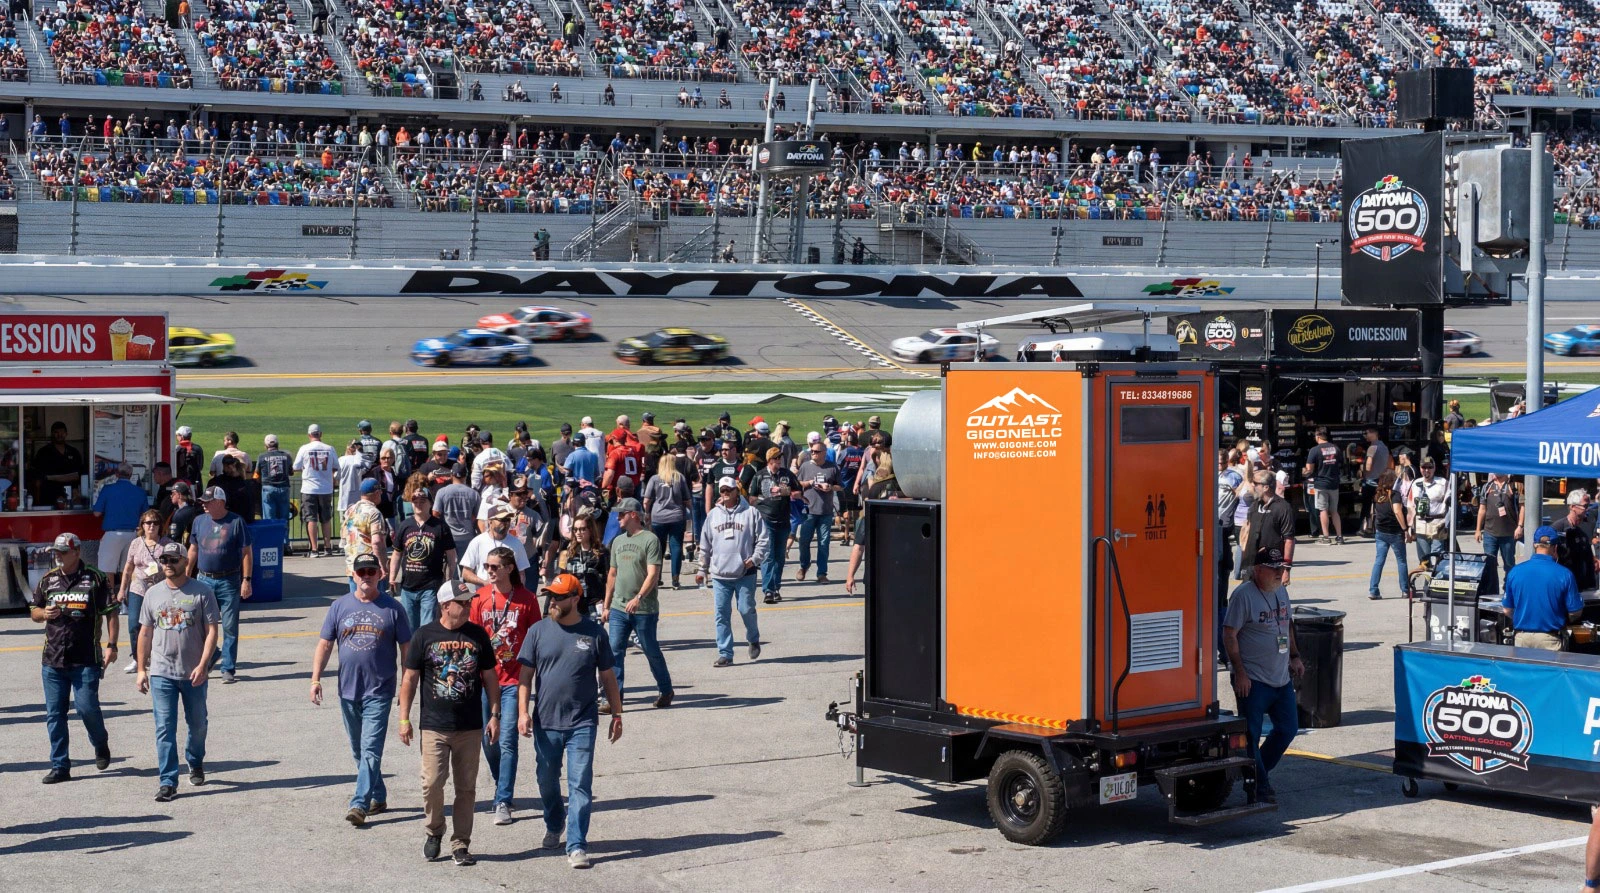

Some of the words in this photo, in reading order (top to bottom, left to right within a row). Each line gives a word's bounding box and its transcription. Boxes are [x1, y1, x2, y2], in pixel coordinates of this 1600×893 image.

[786, 152, 825, 161] DAYTONA
[1361, 192, 1413, 208] DAYTONA
[1356, 207, 1418, 232] 500
[399, 269, 1085, 298] DAYTONA
[1, 323, 96, 354] ESSIONS
[1207, 328, 1233, 338] 500
[1348, 327, 1407, 341] CONCESSION
[1120, 391, 1140, 400] TEL:
[1141, 390, 1192, 400] 8334819686
[966, 413, 1063, 427] OUTLAST
[966, 427, 1063, 440] GIGONELLC
[973, 440, 1057, 450] WWW.GIGONE.COM
[973, 450, 1057, 460] INFO@GIGONE.COM
[1145, 530, 1167, 541] TOILET
[1446, 691, 1509, 711] DAYTONA
[1436, 706, 1519, 739] 500
